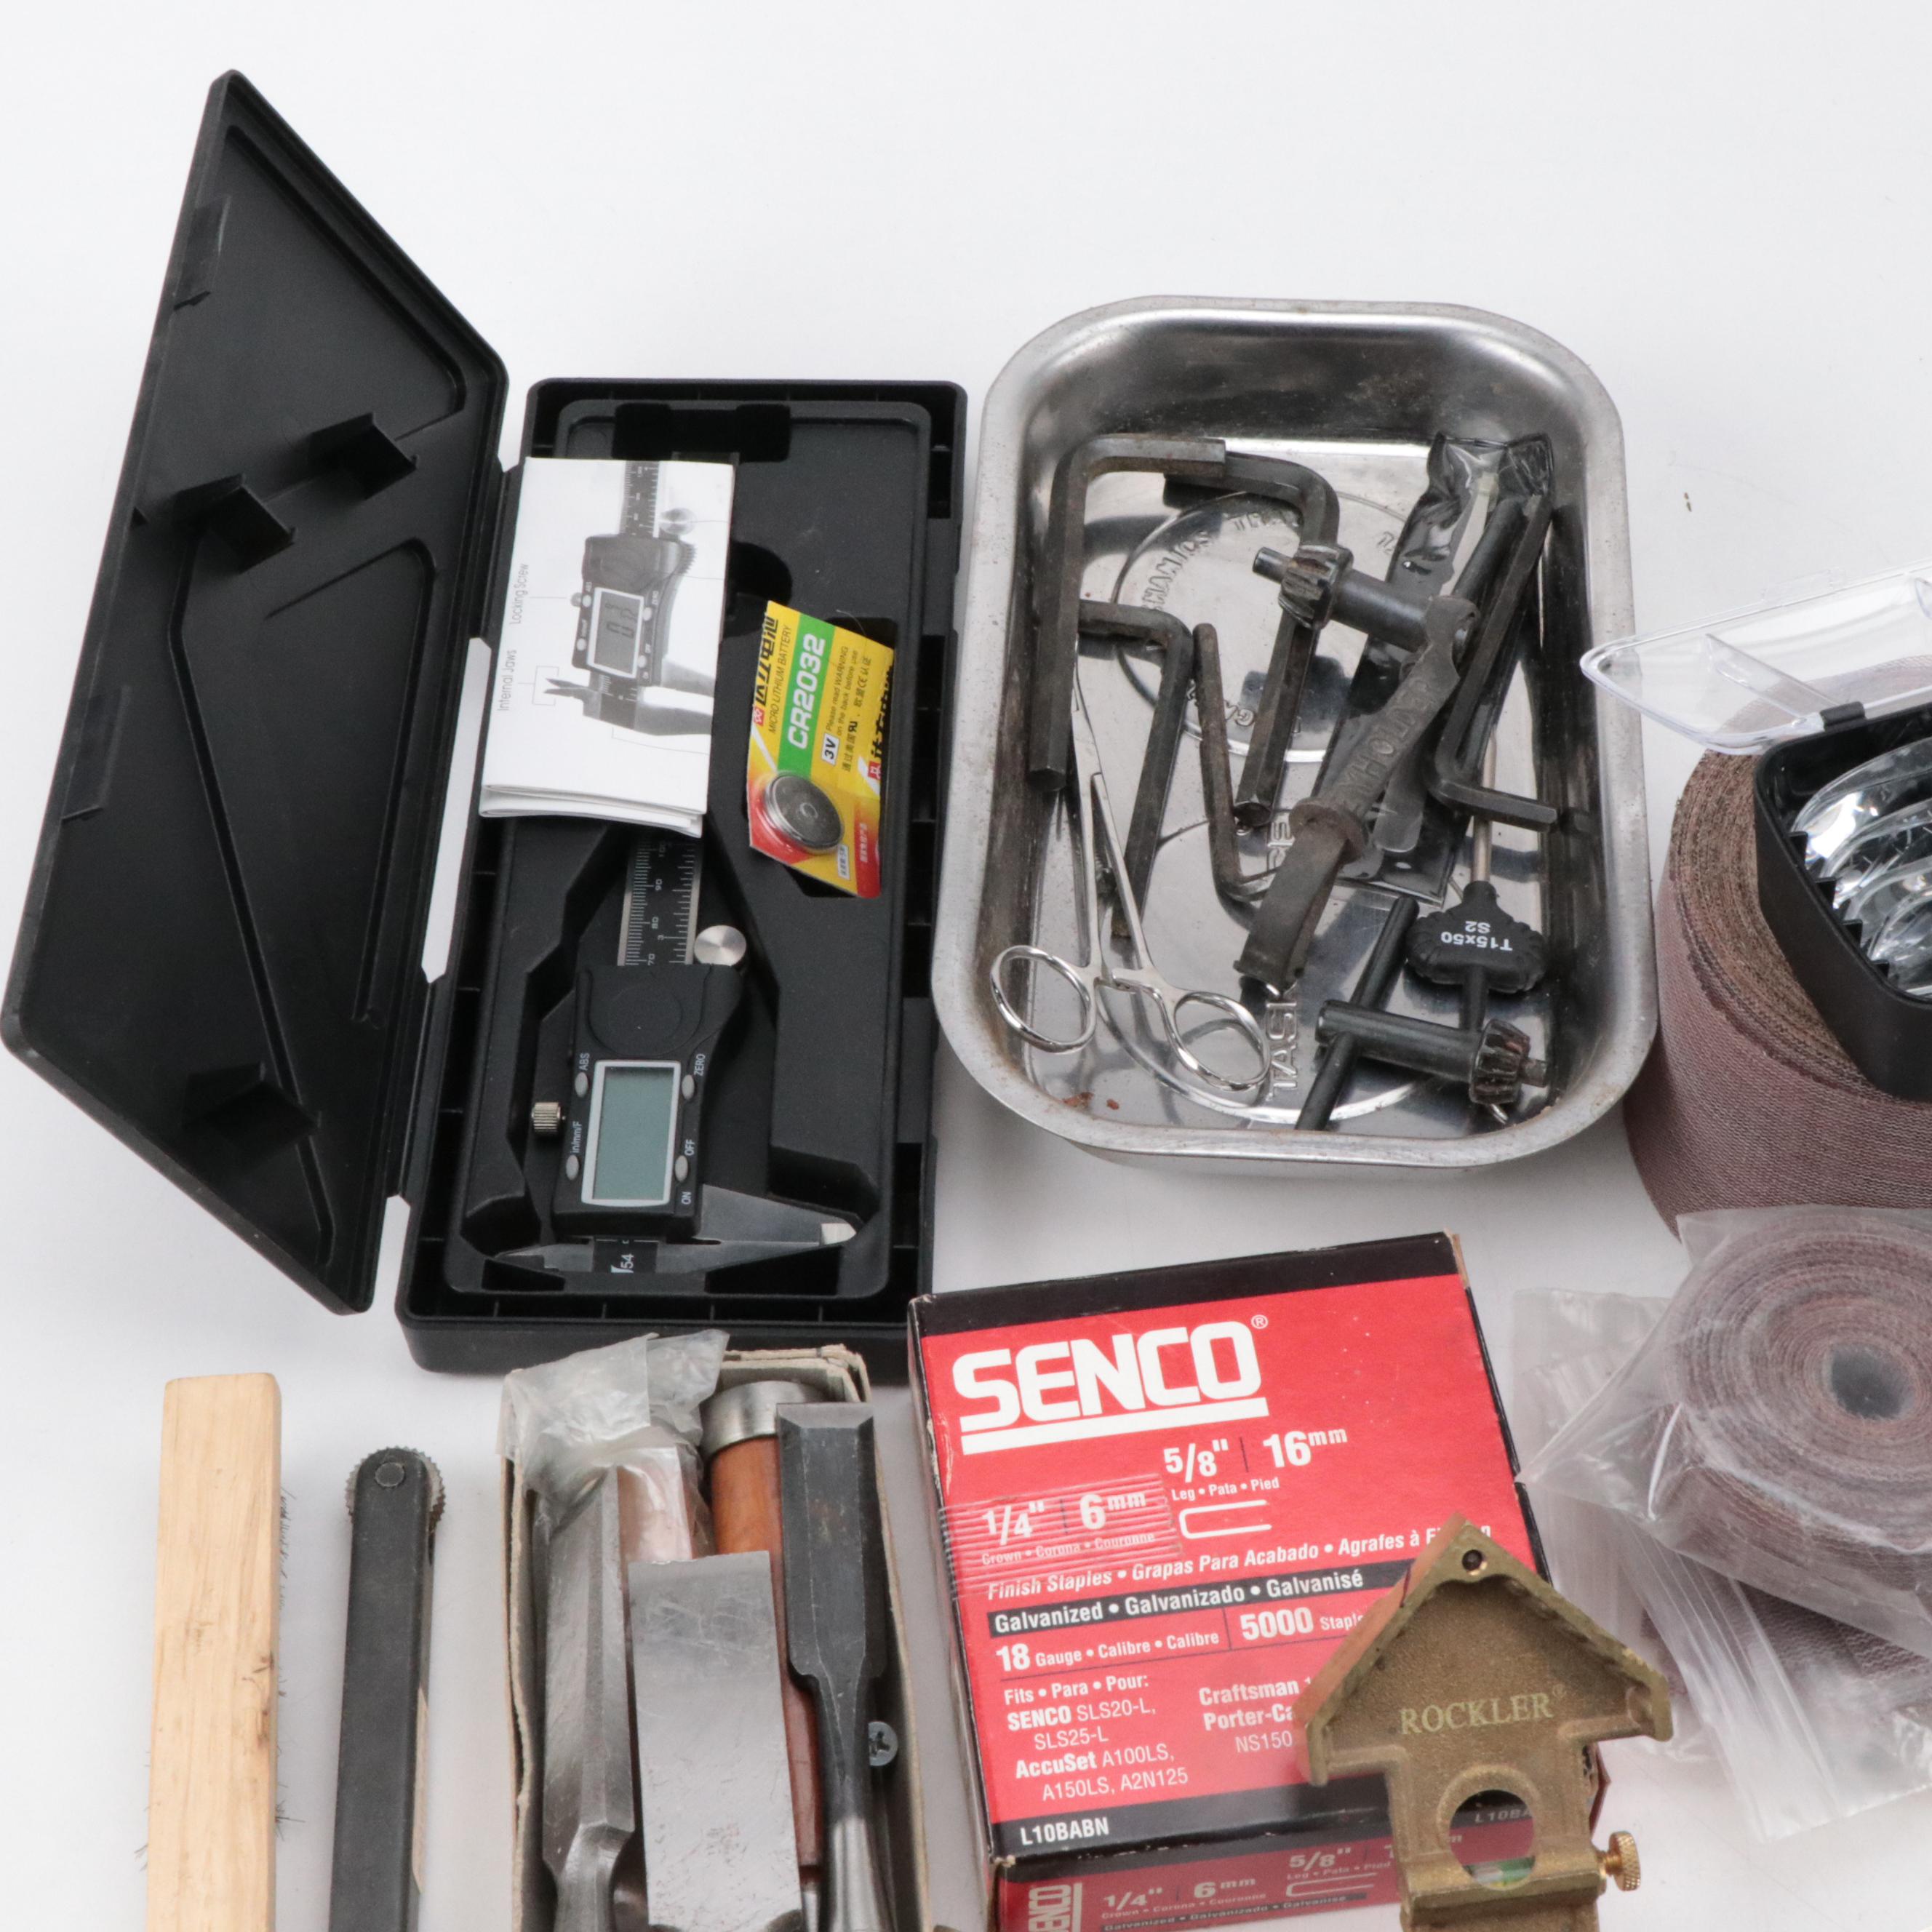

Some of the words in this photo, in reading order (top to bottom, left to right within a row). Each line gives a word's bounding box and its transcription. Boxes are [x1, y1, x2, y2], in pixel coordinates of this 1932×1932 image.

[514, 562, 530, 585] Screw
[509, 585, 528, 624] Locking
[504, 649, 518, 671] Jaws
[778, 626, 792, 666] BATTERY
[834, 646, 848, 686] WARNING
[497, 672, 514, 713] Internal
[773, 666, 786, 703] LITHIUM
[788, 634, 826, 750] CR2032
[831, 687, 840, 704] read
[836, 726, 844, 736] on
[841, 692, 849, 709] back
[845, 666, 855, 690] before
[768, 705, 781, 733] MICRO
[826, 706, 837, 731] Please
[823, 738, 837, 760] 3V
[655, 879, 663, 891] 90
[651, 917, 660, 929] 80
[1464, 920, 1492, 935] S2
[1440, 930, 1514, 952] T15x50
[579, 1052, 591, 1071] ABS
[693, 1053, 706, 1077] ZERO
[684, 1139, 696, 1157] OFF
[681, 1190, 692, 1205] ON
[1163, 1438, 1229, 1484] 5/8"
[1171, 1487, 1196, 1504] Leg
[1209, 1481, 1238, 1496] Pata
[1250, 1476, 1280, 1493] Pied
[982, 1500, 1045, 1546] 1/4"
[982, 1550, 1022, 1567] Crown
[1036, 1541, 1081, 1559] Corona
[1095, 1531, 1156, 1550] Couronne
[988, 1577, 1042, 1601] Finish
[1046, 1570, 1113, 1595] Staples
[1132, 1558, 1195, 1585] Grapas
[1199, 1552, 1240, 1573] Para
[1245, 1541, 1319, 1568] Acabado
[1338, 1534, 1408, 1557] Agrafes
[1409, 1529, 1421, 1547] à
[994, 1602, 1103, 1634] Galvanized
[1125, 1583, 1246, 1616] Galvanizado
[1266, 1569, 1364, 1598] Galvanisé
[996, 1642, 1031, 1672] 18
[1035, 1647, 1083, 1669] Gauge
[1098, 1638, 1151, 1660] Calibre
[1166, 1629, 1220, 1650] Calibre
[1239, 1605, 1314, 1642] 5000
[1005, 1684, 1034, 1706] Fits
[1050, 1678, 1090, 1699] Para
[1106, 1672, 1150, 1692] Pour:
[1199, 1678, 1300, 1707] Craftsman
[1007, 1706, 1072, 1731] SENCO
[1076, 1698, 1157, 1722] SLS20-L,
[1203, 1704, 1294, 1731] Porter-Ca
[1033, 1727, 1110, 1751] SLS25-L
[1015, 1751, 1098, 1779] AccuSet
[1101, 1743, 1175, 1768] A100LS,
[1042, 1776, 1117, 1801] A150LS,
[1120, 1767, 1189, 1792] A2N125
[1020, 1816, 1110, 1846] L10BABN
[1286, 1872, 1310, 1881] Leg
[1322, 1866, 1350, 1876] Pata
[1029, 1884, 1071, 1932] ENCO
[1101, 1909, 1141, 1920] Crown
[1152, 1903, 1196, 1913] Corona
[1208, 1893, 1267, 1905] Couronne
[1104, 1916, 1176, 1932] Galvanized
[1189, 1904, 1269, 1920] Galvanizado
